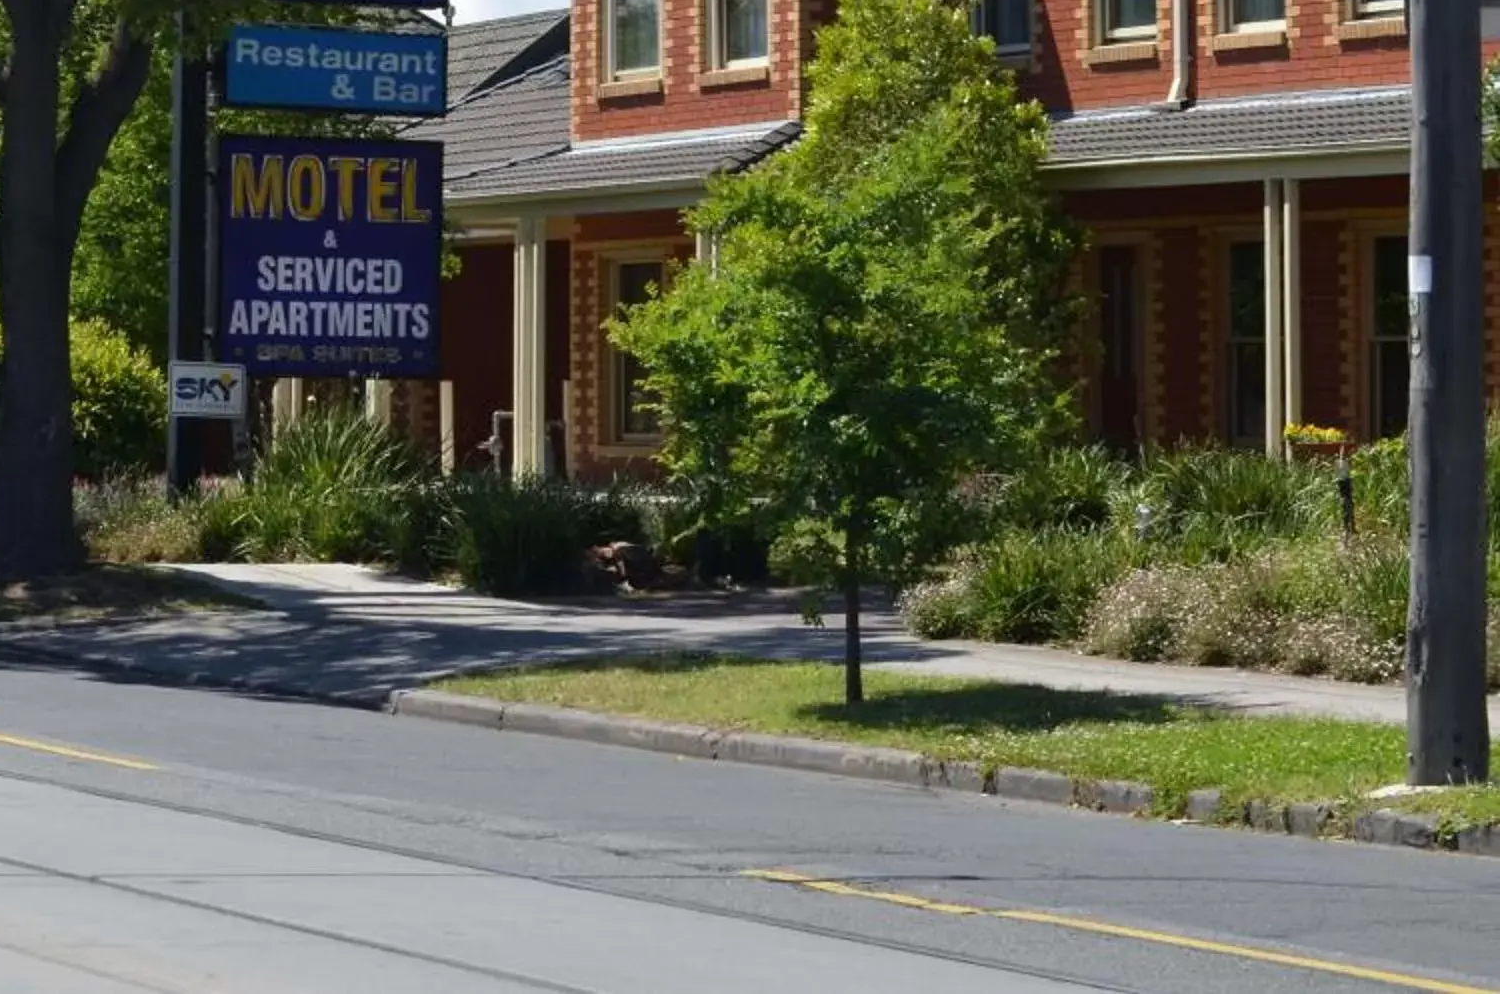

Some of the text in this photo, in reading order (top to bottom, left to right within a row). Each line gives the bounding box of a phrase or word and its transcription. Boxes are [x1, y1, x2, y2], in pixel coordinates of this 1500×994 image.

[235, 38, 437, 74] Restaurant
[331, 74, 436, 103] & Bar
[231, 153, 433, 223] MOTEL
[323, 230, 337, 248] &
[257, 255, 403, 294] SERVICED
[229, 299, 429, 339] APARTMENTS
[175, 376, 238, 402] SKY
